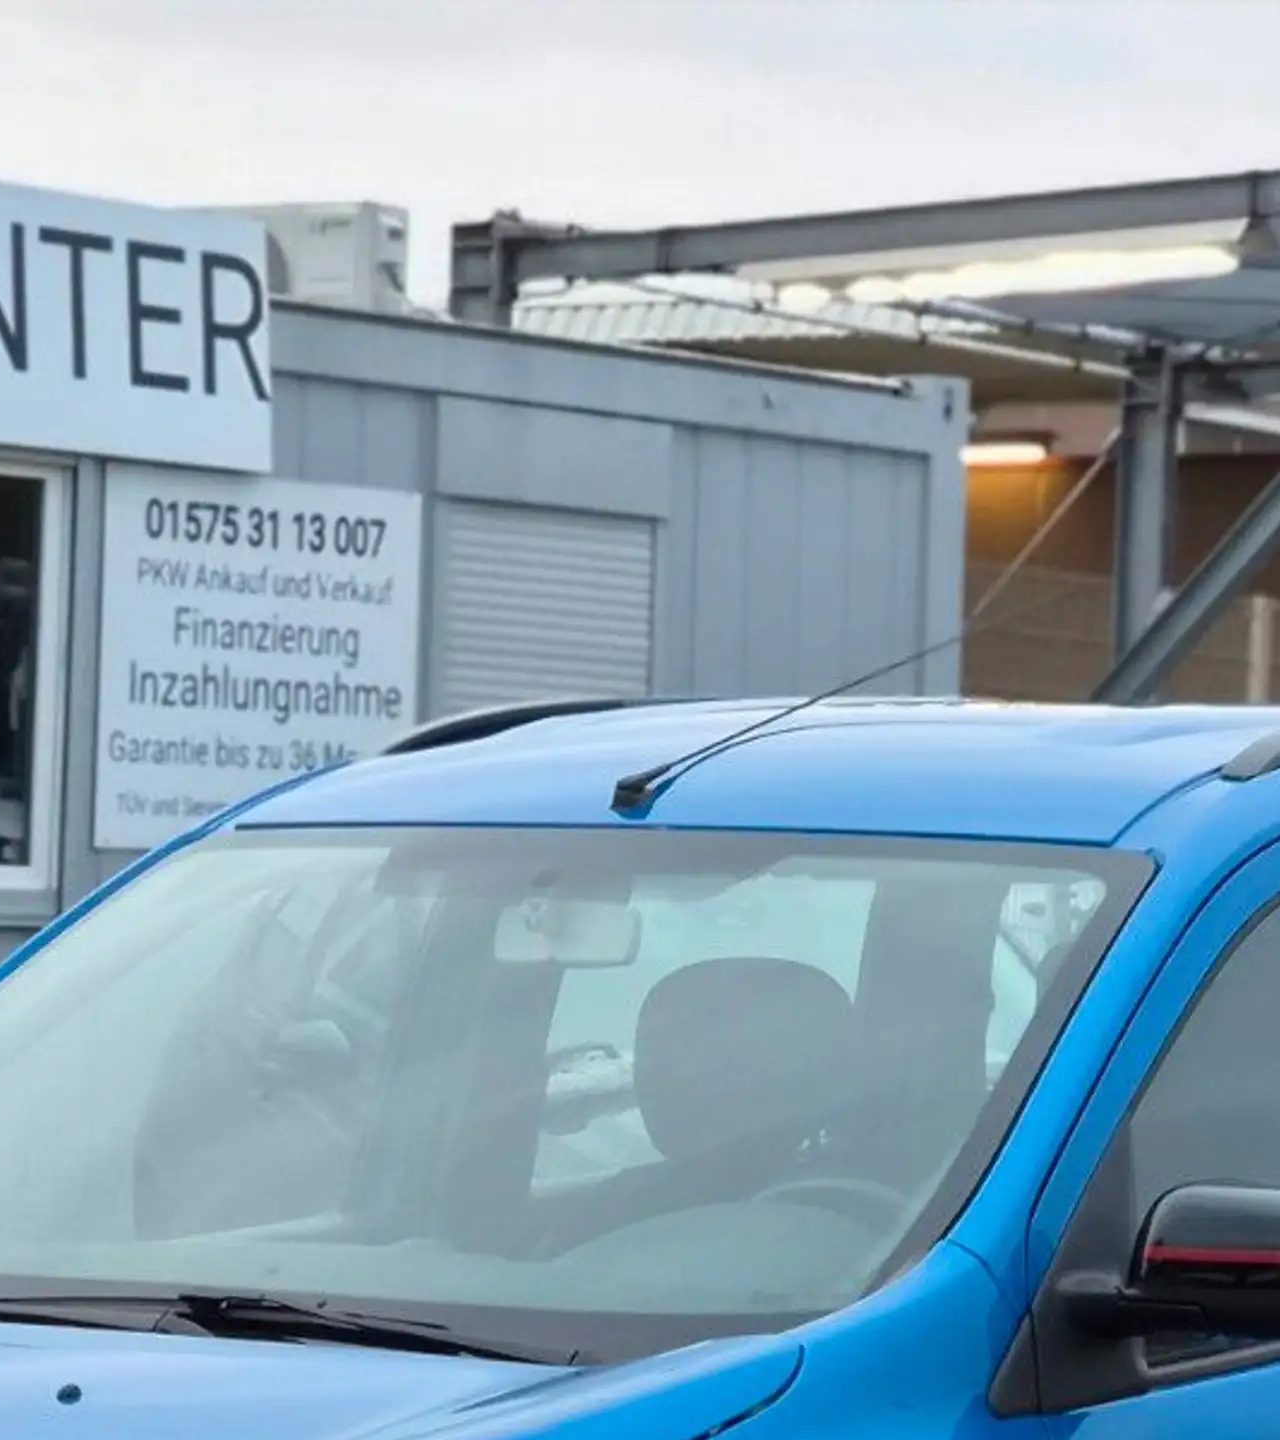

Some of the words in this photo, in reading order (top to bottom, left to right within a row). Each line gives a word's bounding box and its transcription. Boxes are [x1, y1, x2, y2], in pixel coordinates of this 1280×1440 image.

[145, 497, 240, 547] 01575
[247, 507, 279, 550] 31
[292, 512, 326, 552] 13
[334, 516, 387, 559] 007
[136, 556, 190, 589] PKW
[194, 561, 269, 596] Ankauf
[273, 570, 311, 600] und
[317, 572, 394, 606] Verkauf
[173, 605, 360, 668] Finanzierung
[128, 660, 403, 725] Inzahlungnahme
[108, 730, 210, 768] Garantie
[214, 735, 251, 770] bis
[256, 744, 284, 770] zu
[288, 739, 316, 772] 36
